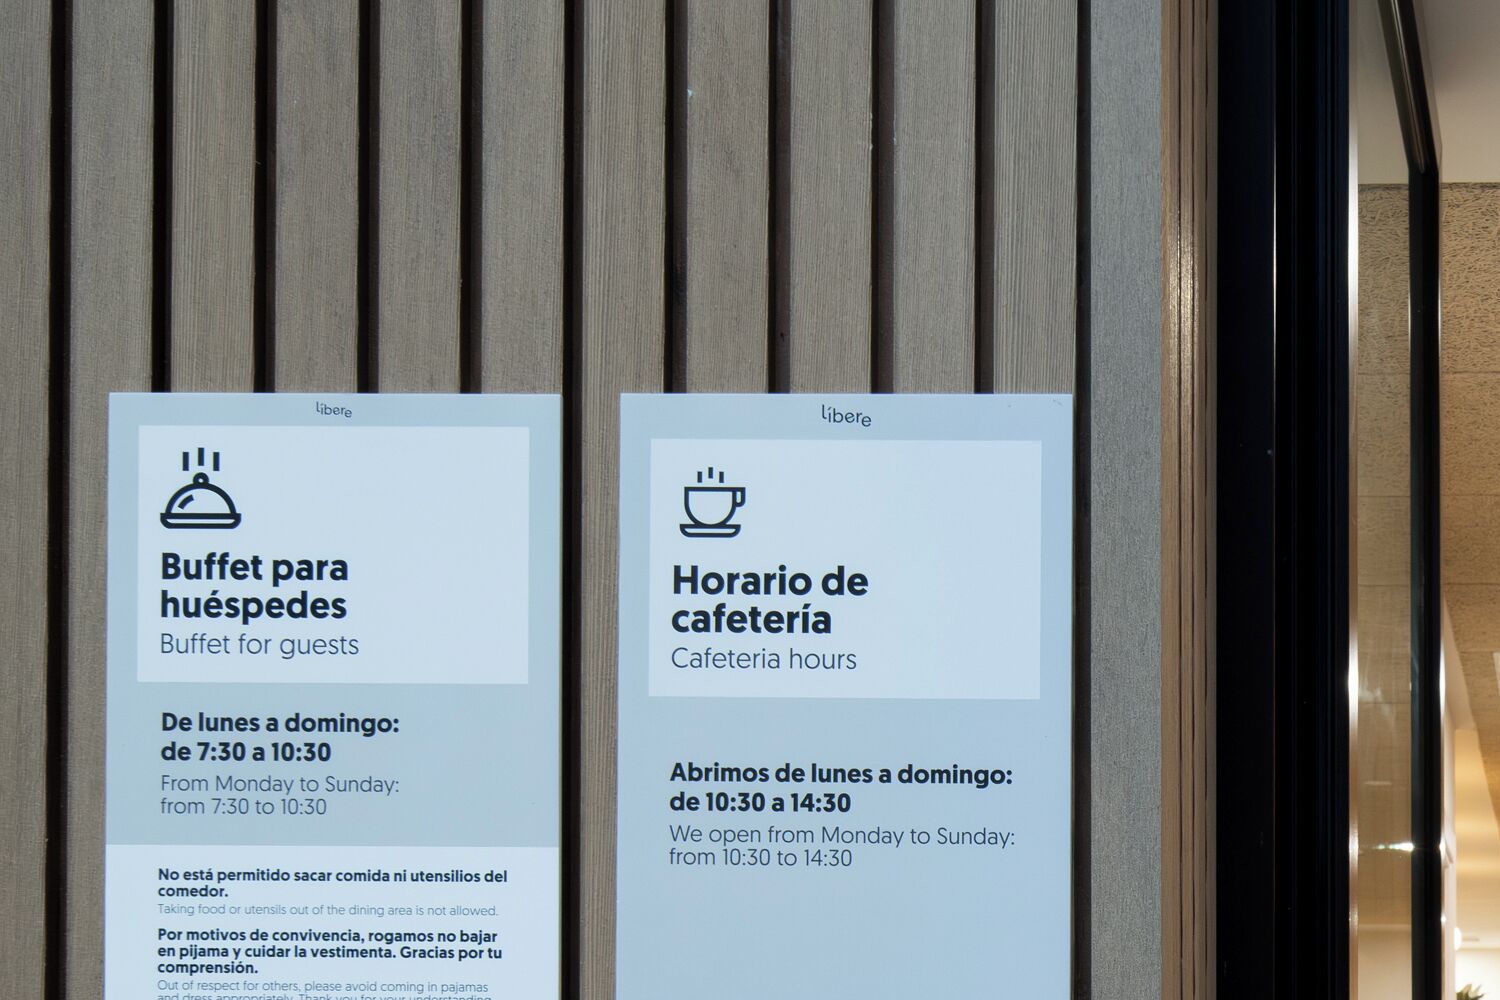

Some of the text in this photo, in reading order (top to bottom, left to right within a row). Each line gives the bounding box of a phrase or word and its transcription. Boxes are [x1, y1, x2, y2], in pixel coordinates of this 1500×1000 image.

[162, 551, 348, 588] Buffet para
[673, 564, 869, 596] Horario de
[161, 589, 347, 626] huéspedes
[671, 602, 831, 634] cafetería
[161, 632, 359, 660] Buffet for guests
[671, 647, 857, 670] Cafeteria hours
[162, 712, 399, 738] De lunes a domingo:
[161, 741, 331, 762] de 7:30 a 10:30
[161, 774, 399, 796] From Monday to Sunday:
[670, 761, 1012, 789] Abrimos de lunes a domingo:
[160, 797, 327, 815] from 7:30 to 10:30
[669, 791, 851, 813] de 10:30 a 14:30
[669, 825, 1015, 849] We open from Monday to Sunday:
[669, 847, 852, 867] from 10:30 to 14:30
[158, 868, 507, 884] No está permitido sacar comida ni utensilios del
[158, 884, 228, 897] comedor.
[157, 903, 499, 918] Taking food or utensils out of the dining area is not allowed.
[158, 928, 498, 946] Por motivos de convivencia, rogamos no bajar
[157, 944, 502, 962] en pijama y cuidar la vestimenta. Gracias por tu
[157, 960, 258, 977] comprensión.
[157, 979, 488, 995] Out of respect for others, please avoid coming in pajamas
